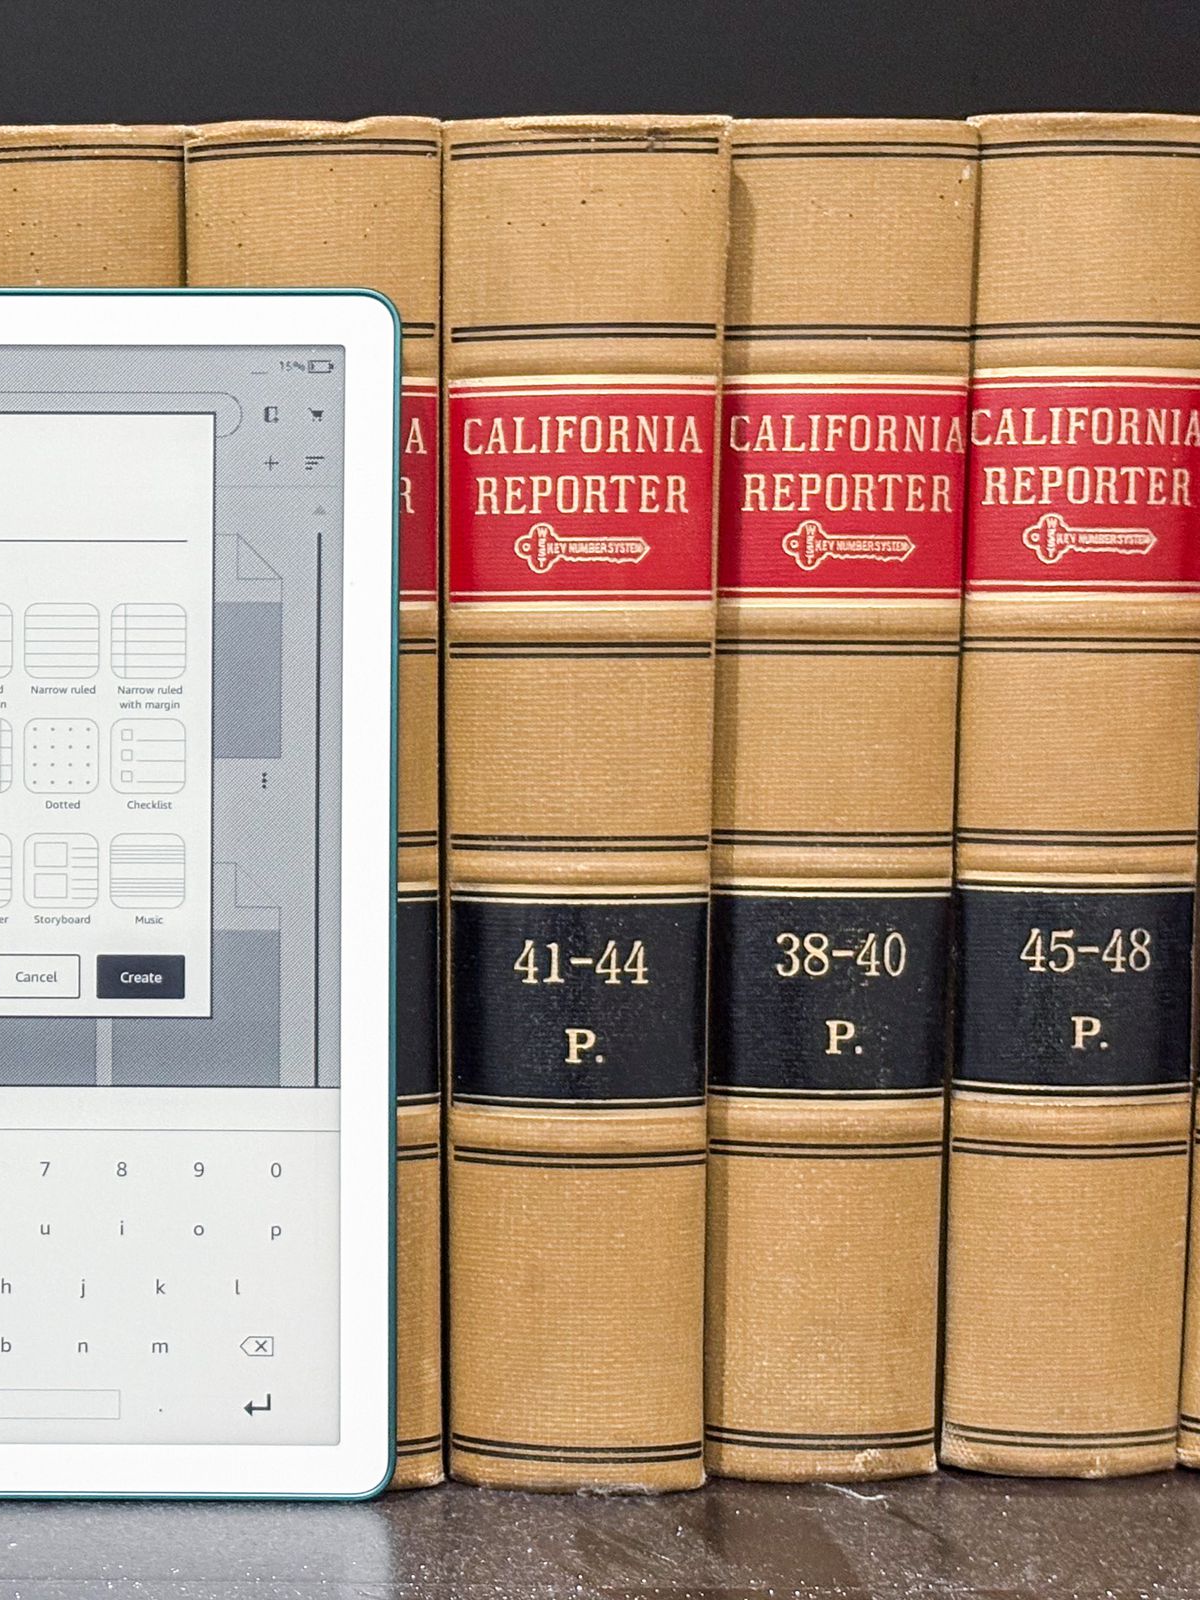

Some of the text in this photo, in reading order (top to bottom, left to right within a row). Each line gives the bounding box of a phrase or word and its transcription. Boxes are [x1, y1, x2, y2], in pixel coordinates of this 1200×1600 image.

[463, 415, 703, 455] CALIFORNIA
[729, 414, 965, 454] CALIFORNIA
[971, 407, 1200, 447] CALIFORNIA
[475, 474, 689, 515] REPORTER
[741, 473, 952, 513] REPORTER
[981, 466, 1191, 507] REPORTER
[546, 543, 568, 554] KEY
[815, 540, 835, 552] KEY
[30, 684, 97, 695] Narrow ruled
[117, 684, 183, 695] Narrow ruled
[119, 699, 181, 712] with margin
[45, 799, 81, 810] Dotted
[126, 799, 173, 810] Checklist
[33, 914, 92, 927] Storyboard
[134, 915, 164, 925] Music
[775, 932, 907, 977] 38-40
[1019, 928, 1151, 972] 45-48
[514, 940, 649, 984] 41-44
[15, 970, 58, 983] Cancel
[121, 972, 162, 983] Create
[825, 1019, 864, 1055] P.
[1071, 1015, 1109, 1051] P.
[564, 1028, 605, 1064] P.
[39, 1161, 51, 1177] 7
[116, 1161, 128, 1178] 8
[193, 1161, 205, 1178] 9
[270, 1162, 282, 1179] 0
[40, 1223, 51, 1236] u
[120, 1220, 124, 1236] i
[193, 1224, 205, 1237] o
[270, 1225, 282, 1241] p
[0, 1277, 12, 1295] h
[79, 1278, 86, 1299] j
[155, 1278, 166, 1295] k
[235, 1278, 241, 1296] l
[0, 1336, 12, 1353] b
[77, 1341, 89, 1354] n
[151, 1341, 169, 1354] m
